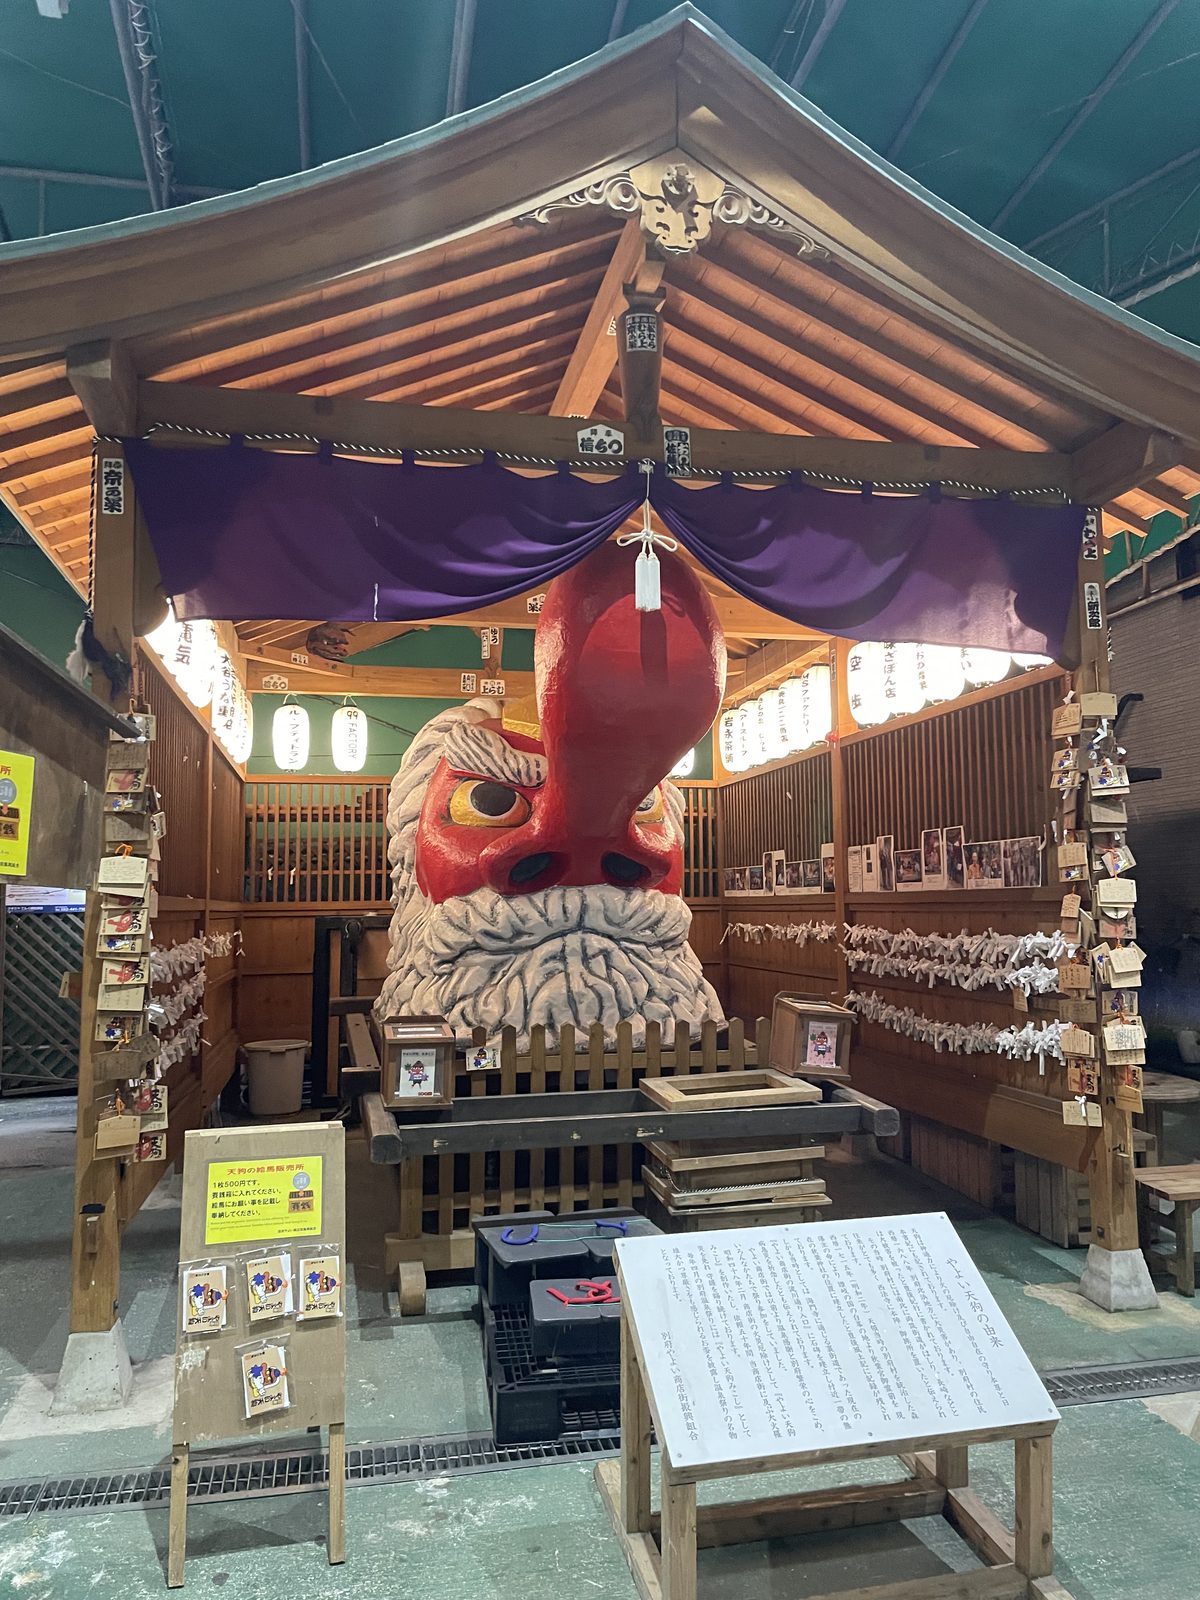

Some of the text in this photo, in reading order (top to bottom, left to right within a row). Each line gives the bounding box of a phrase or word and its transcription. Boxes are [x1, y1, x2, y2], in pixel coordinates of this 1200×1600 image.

[227, 1164, 305, 1175] 天狗の絵馬販売所
[945, 1257, 1004, 1348] やよい天狗の由来
[660, 1331, 699, 1441] 別府やよい商店街振興組合
